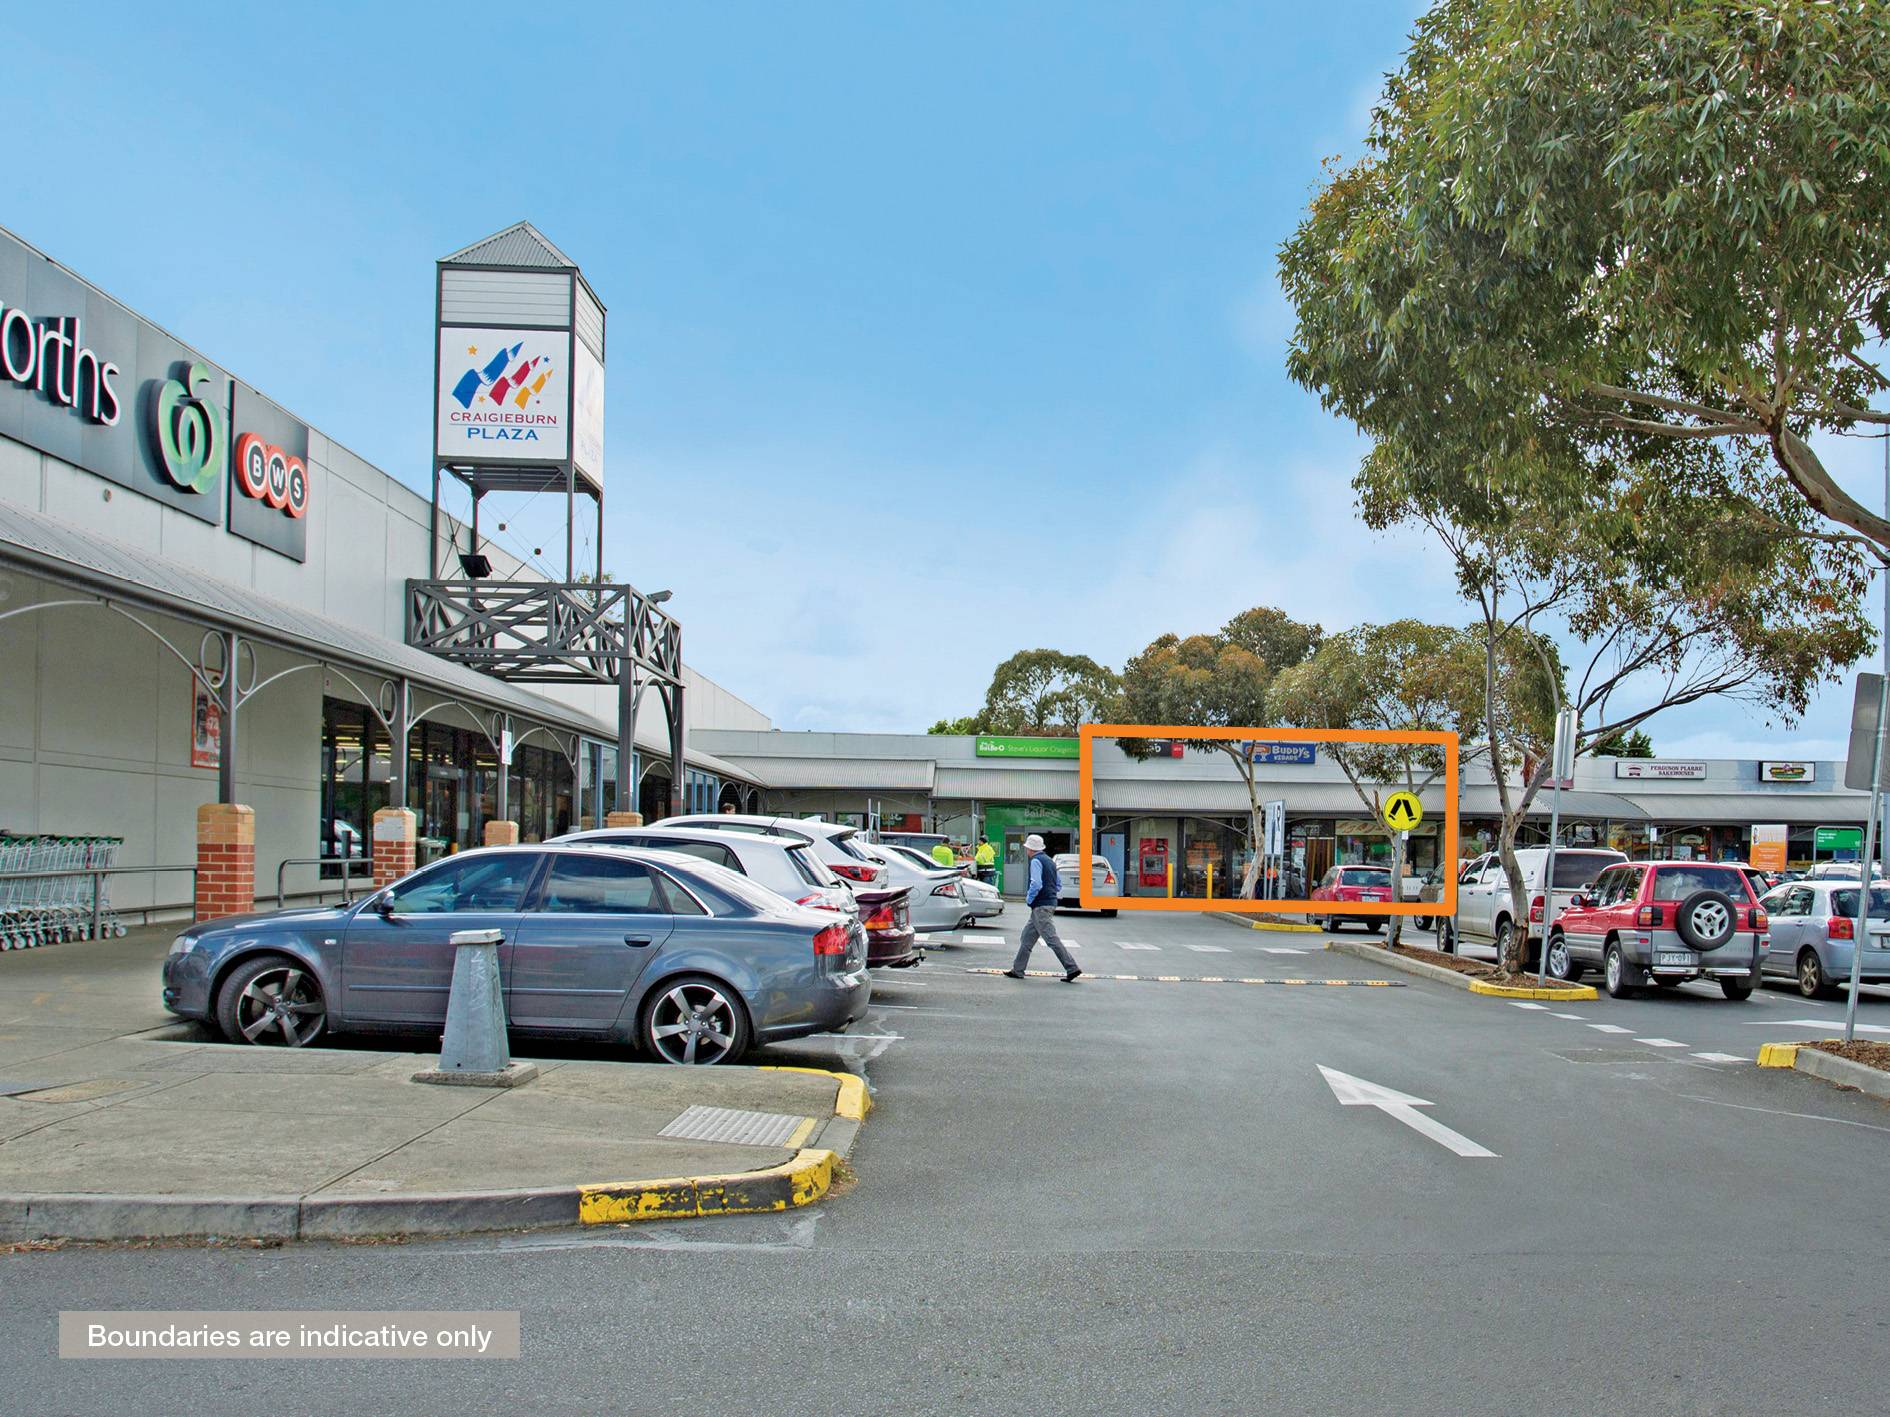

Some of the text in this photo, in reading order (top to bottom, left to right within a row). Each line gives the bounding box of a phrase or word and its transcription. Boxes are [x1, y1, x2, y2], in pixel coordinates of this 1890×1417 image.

[0, 301, 121, 426] orths
[450, 412, 557, 424] CRAIGIEBURN
[467, 427, 539, 440] PLAZA
[253, 454, 303, 499] BWS
